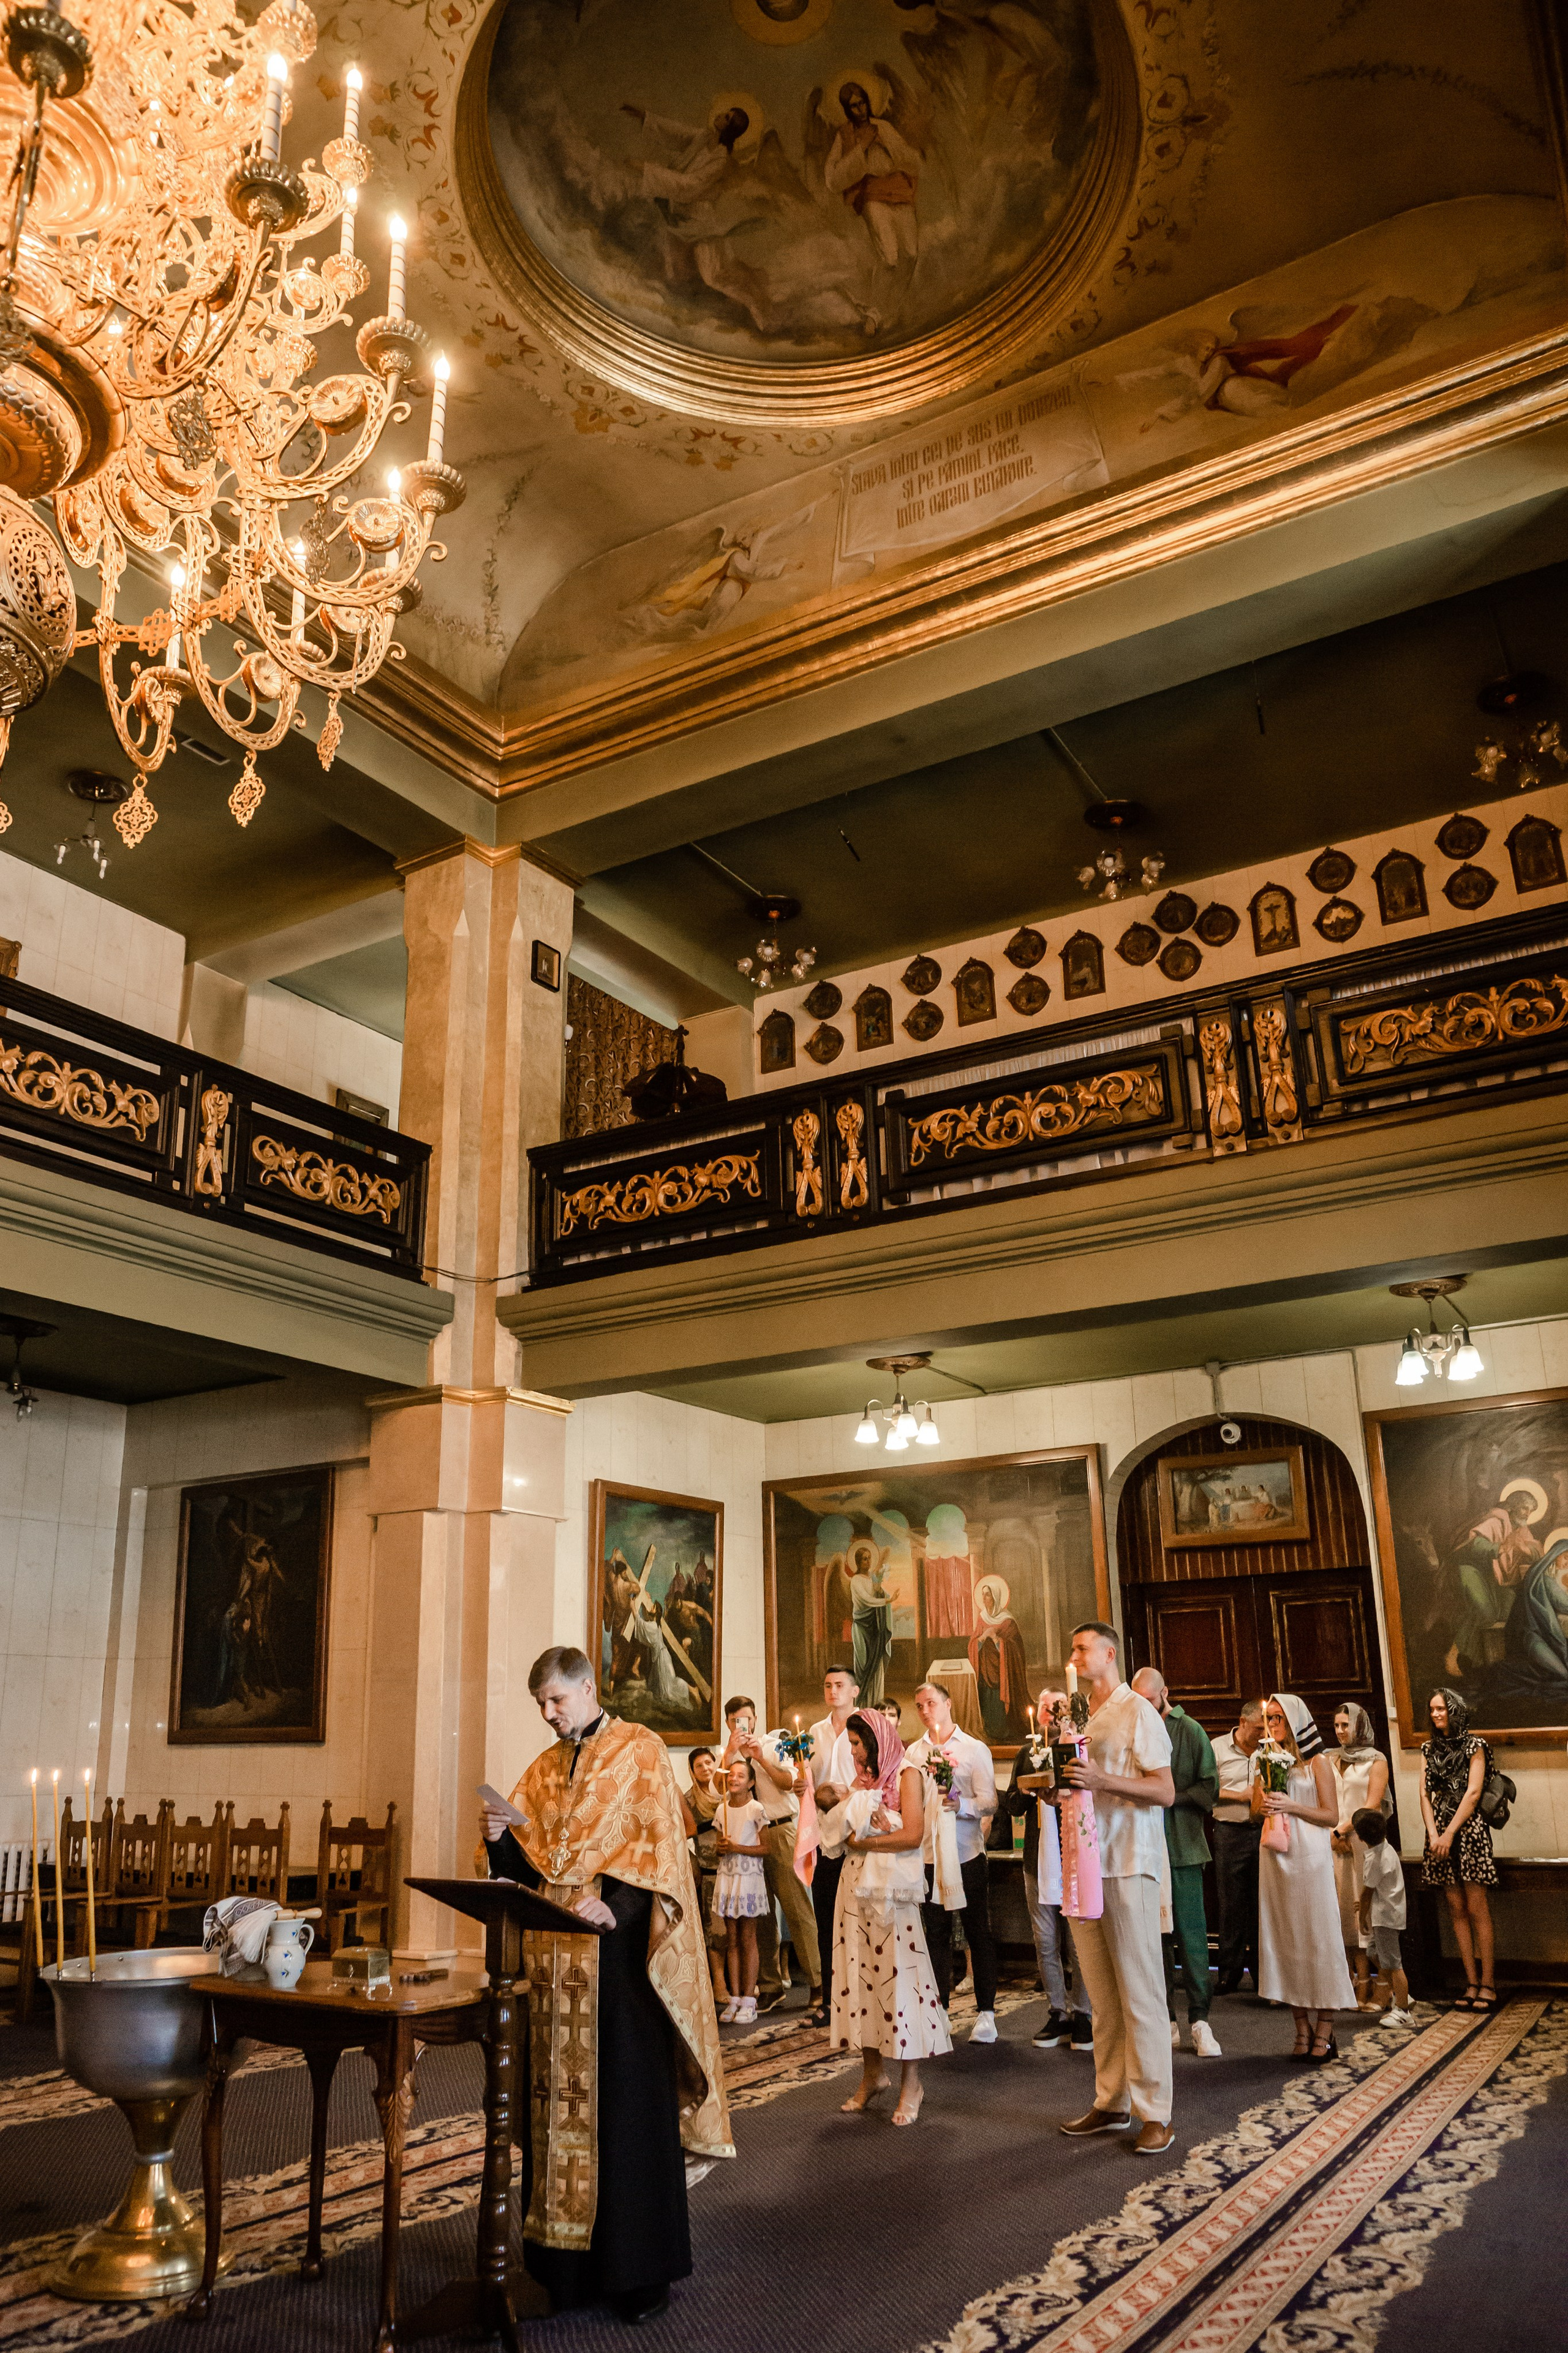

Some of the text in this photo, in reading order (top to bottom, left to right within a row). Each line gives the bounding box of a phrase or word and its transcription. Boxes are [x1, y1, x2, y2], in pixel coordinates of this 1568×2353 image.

[946, 432, 963, 456] DE
[968, 420, 991, 446] SUS
[918, 470, 933, 494] PE
